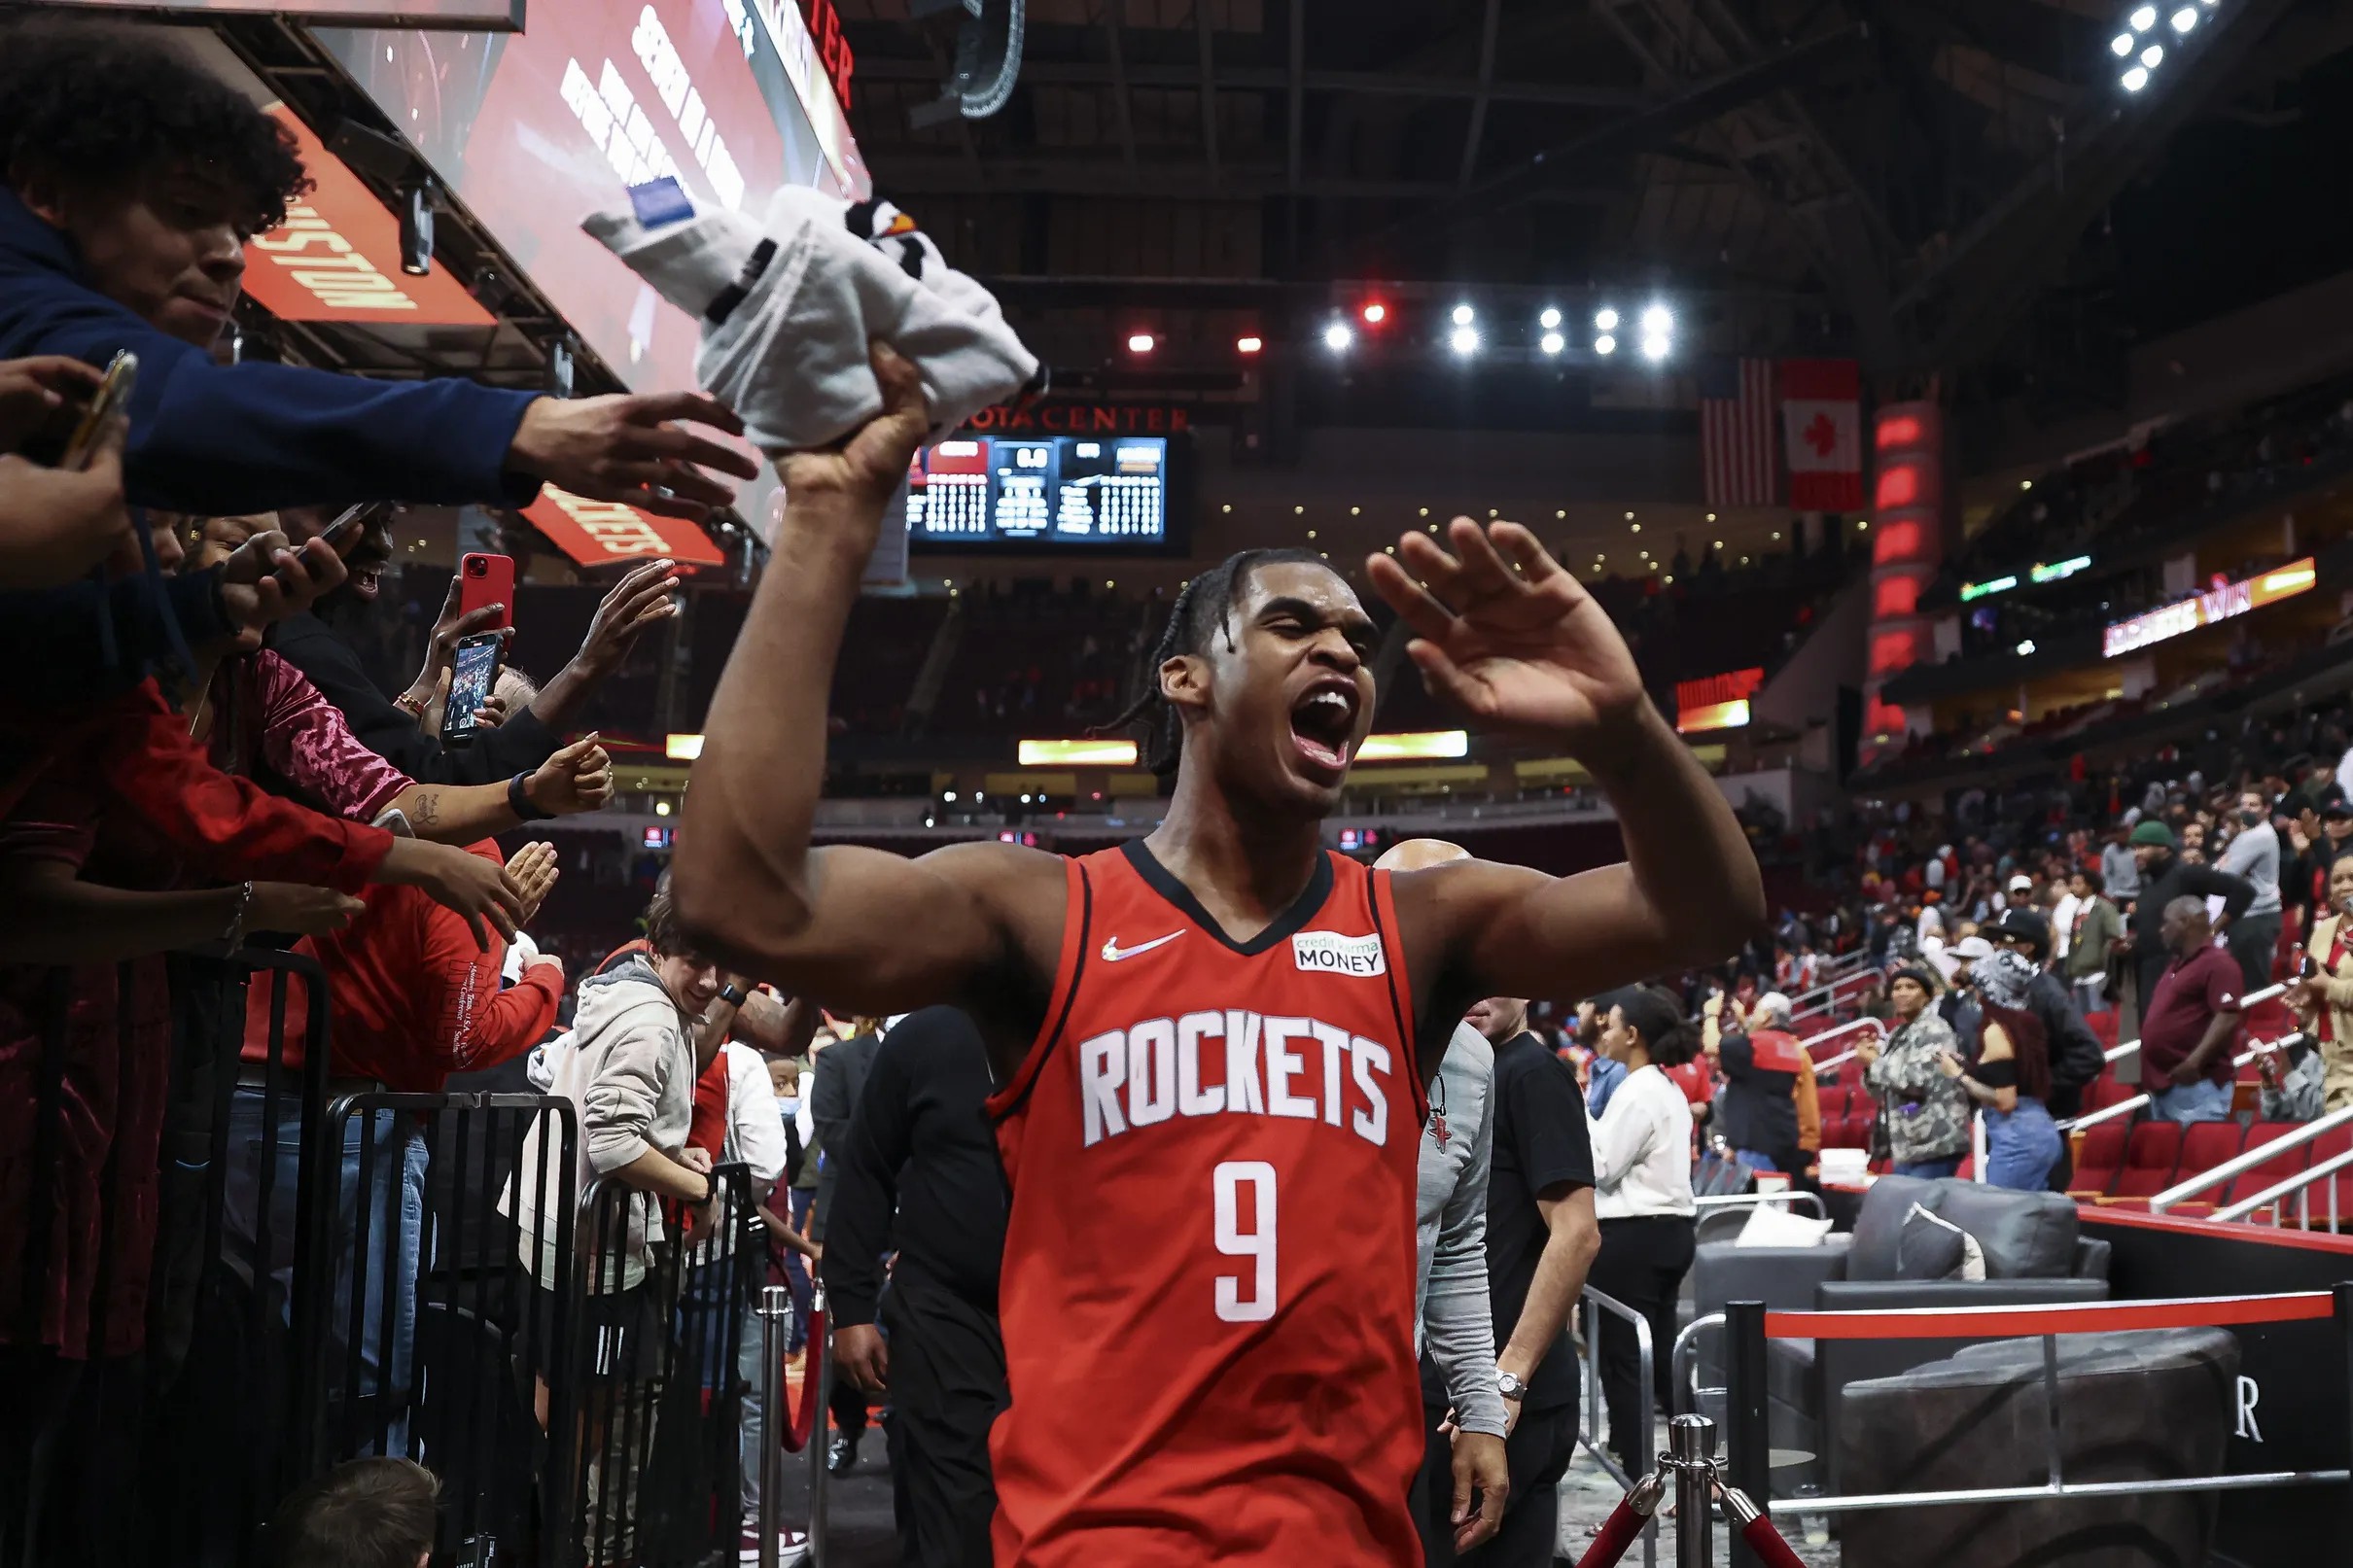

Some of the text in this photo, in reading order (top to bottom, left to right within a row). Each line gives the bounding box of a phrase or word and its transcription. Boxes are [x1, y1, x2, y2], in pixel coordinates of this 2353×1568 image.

[252, 195, 418, 309] STON
[963, 405, 1188, 432] OTA CENTER
[543, 482, 672, 553] CKETS
[1296, 936, 1337, 951] credit
[1299, 950, 1378, 973] MONEY
[457, 987, 468, 1021] Conference
[1079, 1008, 1391, 1148] ROCKETS
[1213, 1161, 1278, 1322] 9
[2234, 1375, 2264, 1443] R
